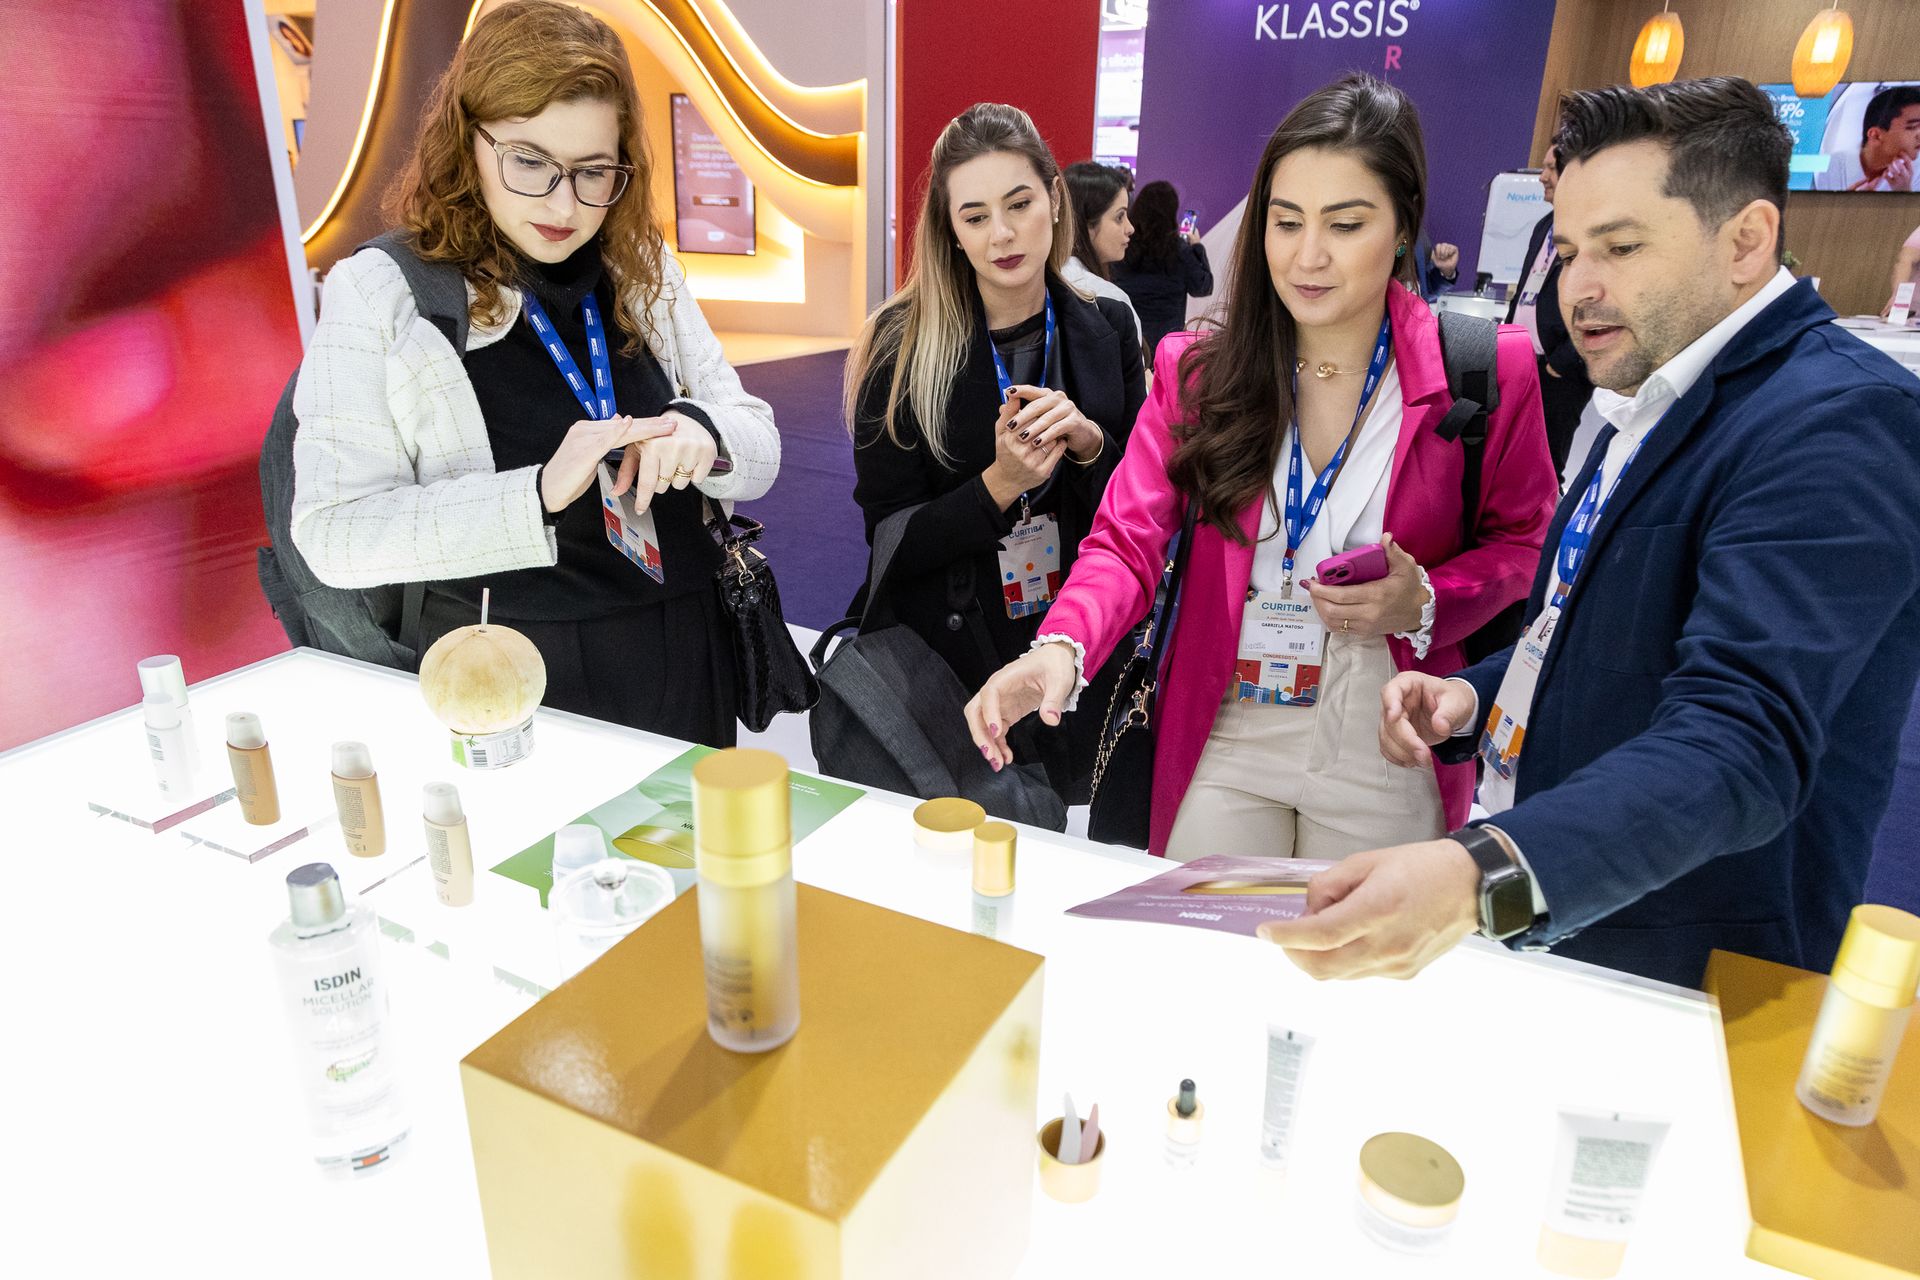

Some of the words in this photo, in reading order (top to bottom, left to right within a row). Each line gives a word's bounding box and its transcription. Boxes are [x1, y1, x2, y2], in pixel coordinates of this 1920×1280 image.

[1384, 45, 1402, 70] R
[1178, 911, 1223, 922] ISDIN
[303, 977, 374, 1006] MICELLAR
[314, 966, 361, 992] ISDIN
